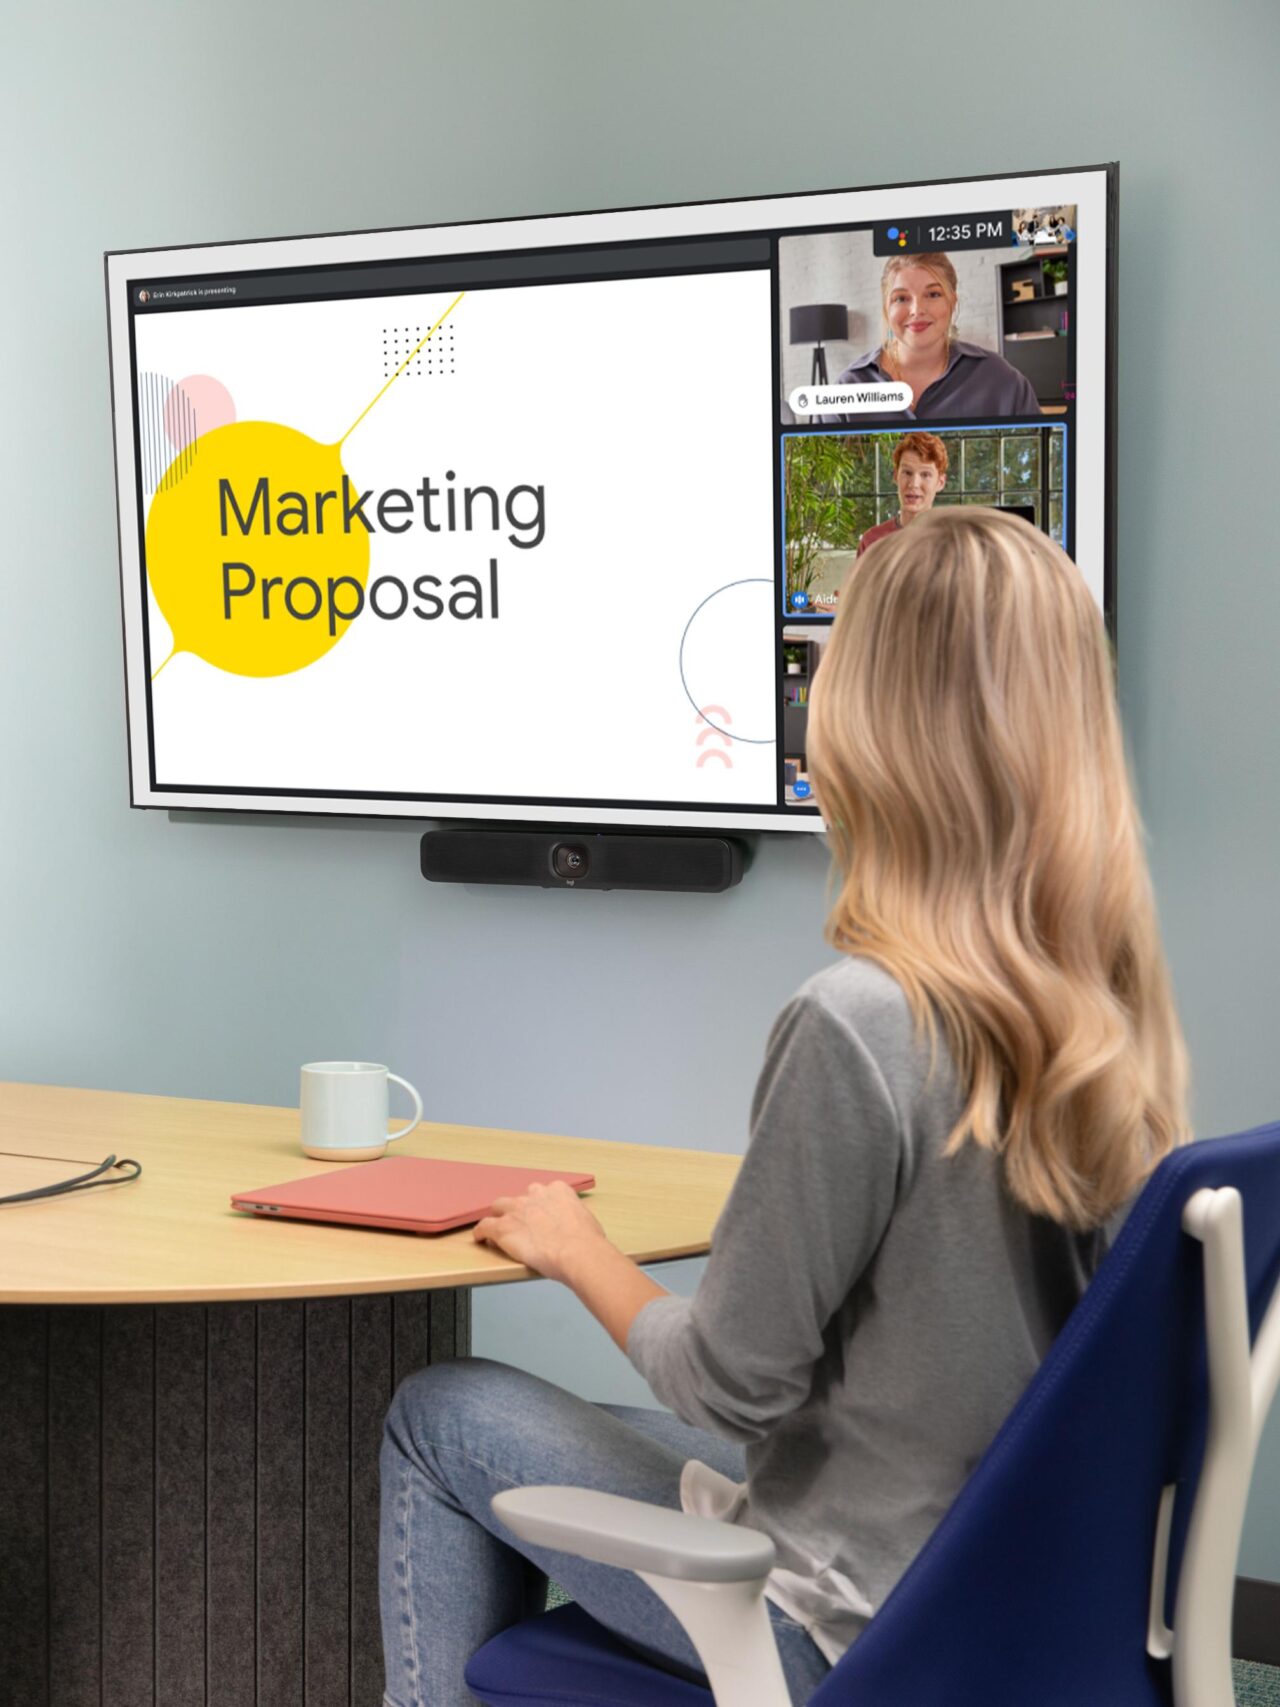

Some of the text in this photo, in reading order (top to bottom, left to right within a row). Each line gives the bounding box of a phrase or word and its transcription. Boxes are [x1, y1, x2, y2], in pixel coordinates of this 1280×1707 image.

[928, 221, 1003, 242] 12:35 PM
[204, 286, 236, 296] presenting
[815, 389, 904, 405] Lauren Williams
[218, 470, 546, 549] Marketing
[222, 558, 500, 636] Proposal
